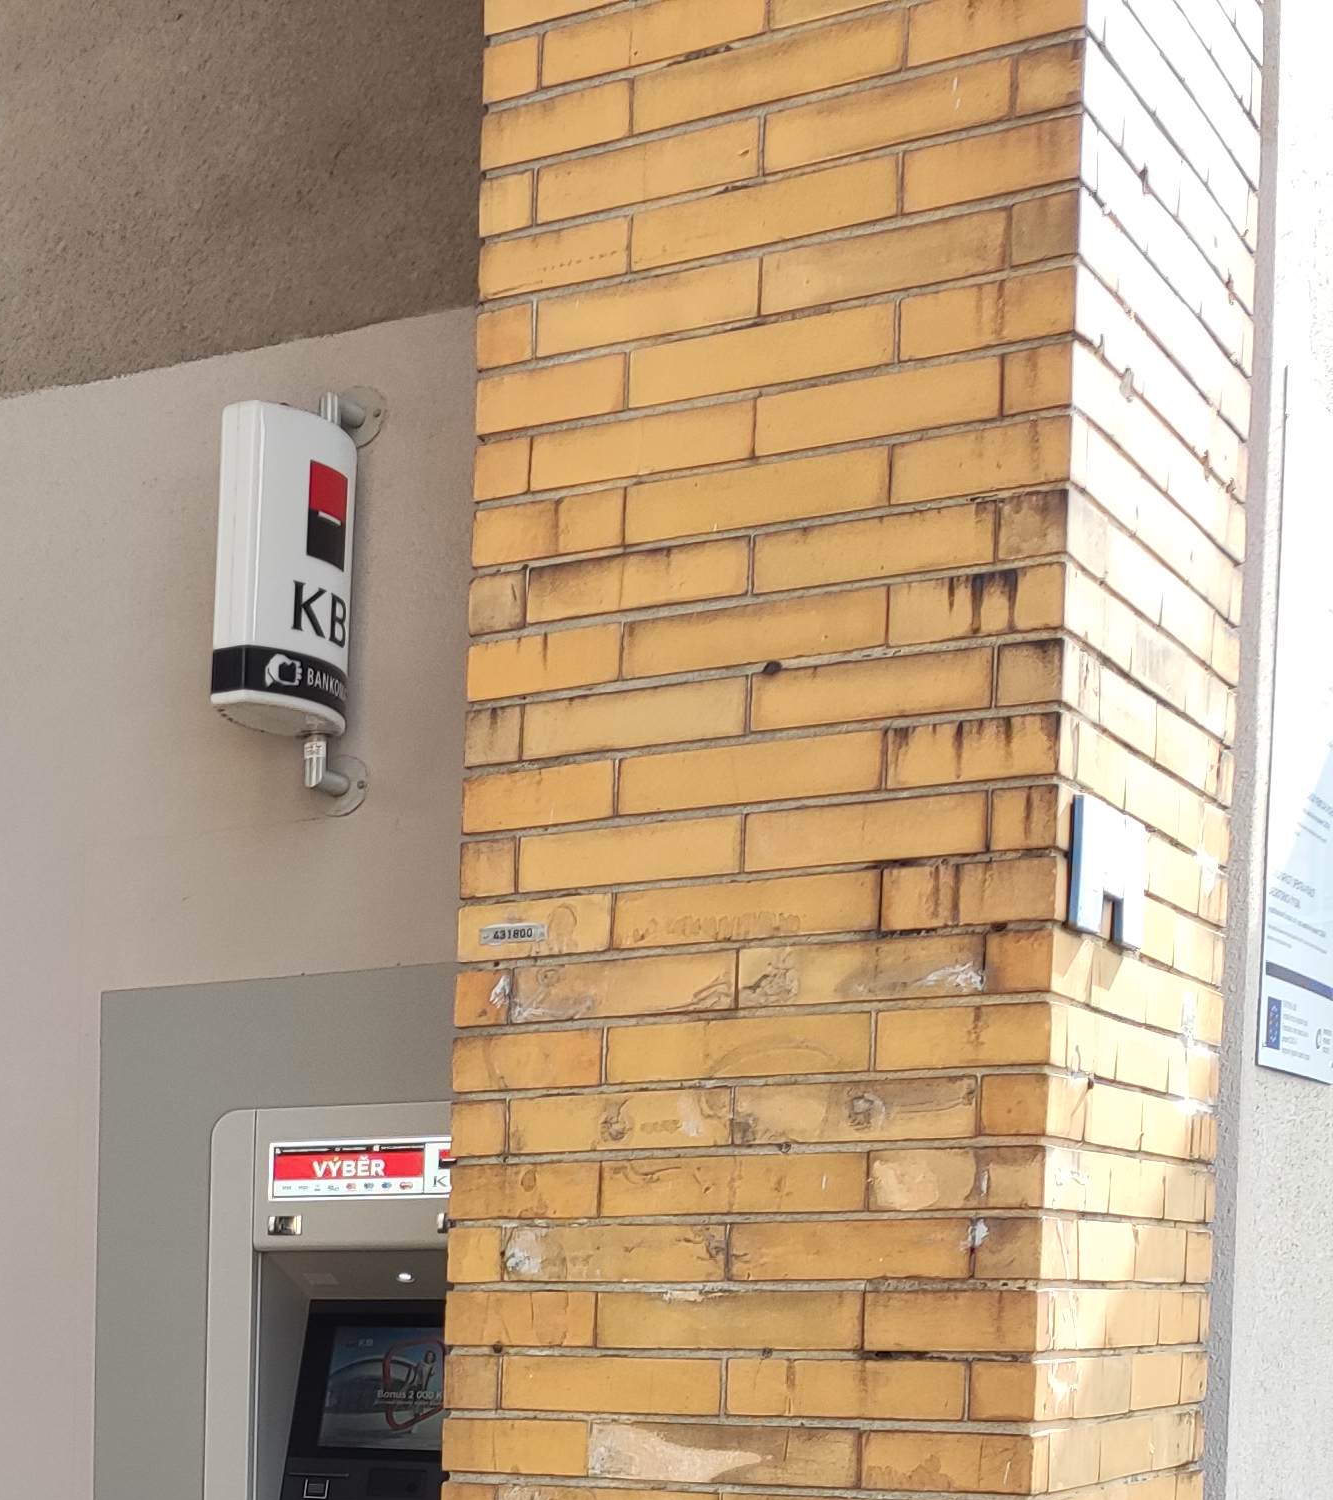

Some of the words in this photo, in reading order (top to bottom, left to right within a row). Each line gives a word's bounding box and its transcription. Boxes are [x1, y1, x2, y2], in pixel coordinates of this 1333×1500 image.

[290, 579, 347, 649] KB
[493, 927, 533, 940] 431800
[311, 1155, 386, 1178] VÝBĚR
